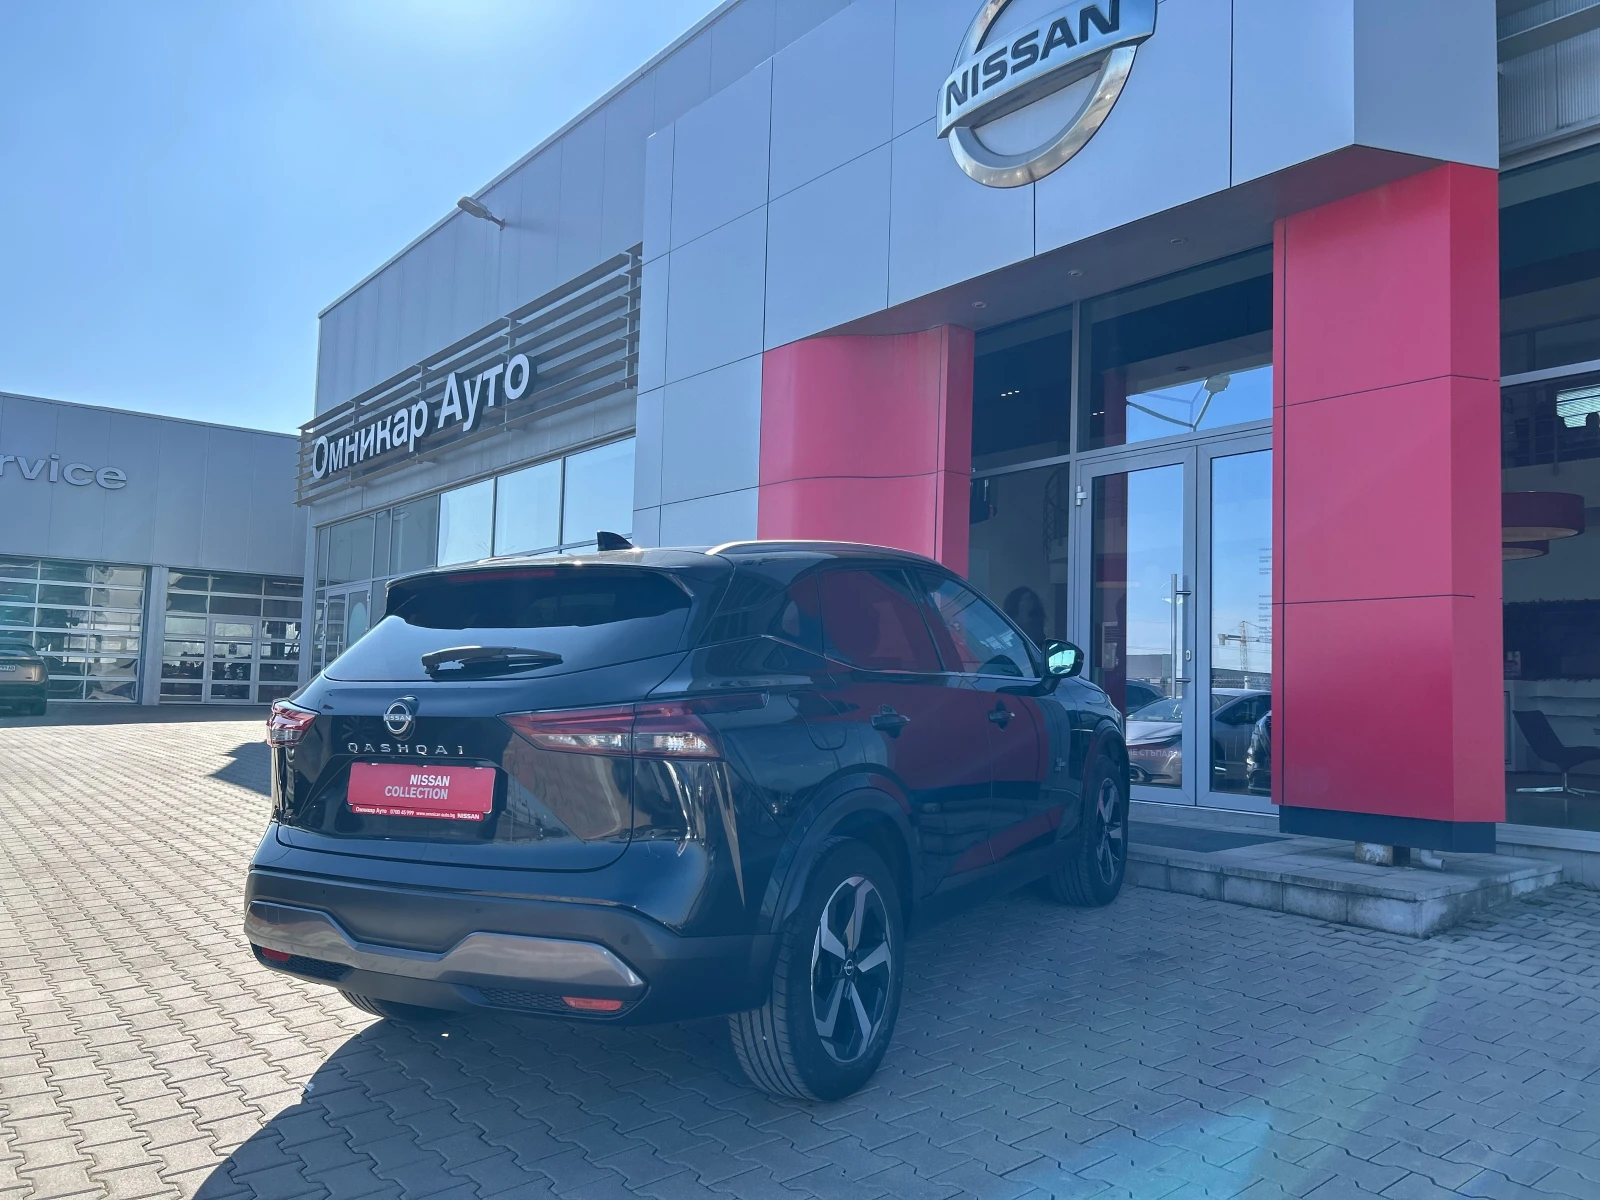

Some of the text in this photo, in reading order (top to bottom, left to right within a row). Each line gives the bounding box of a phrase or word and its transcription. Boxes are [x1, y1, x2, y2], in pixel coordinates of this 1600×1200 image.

[945, 0, 1120, 116] NISSAN
[312, 353, 531, 480] Омникар Ауто
[347, 742, 464, 756] QASHQAI
[409, 774, 450, 787] NISSAN
[384, 785, 448, 800] COLLECTION
[457, 812, 480, 820] NISSAN
